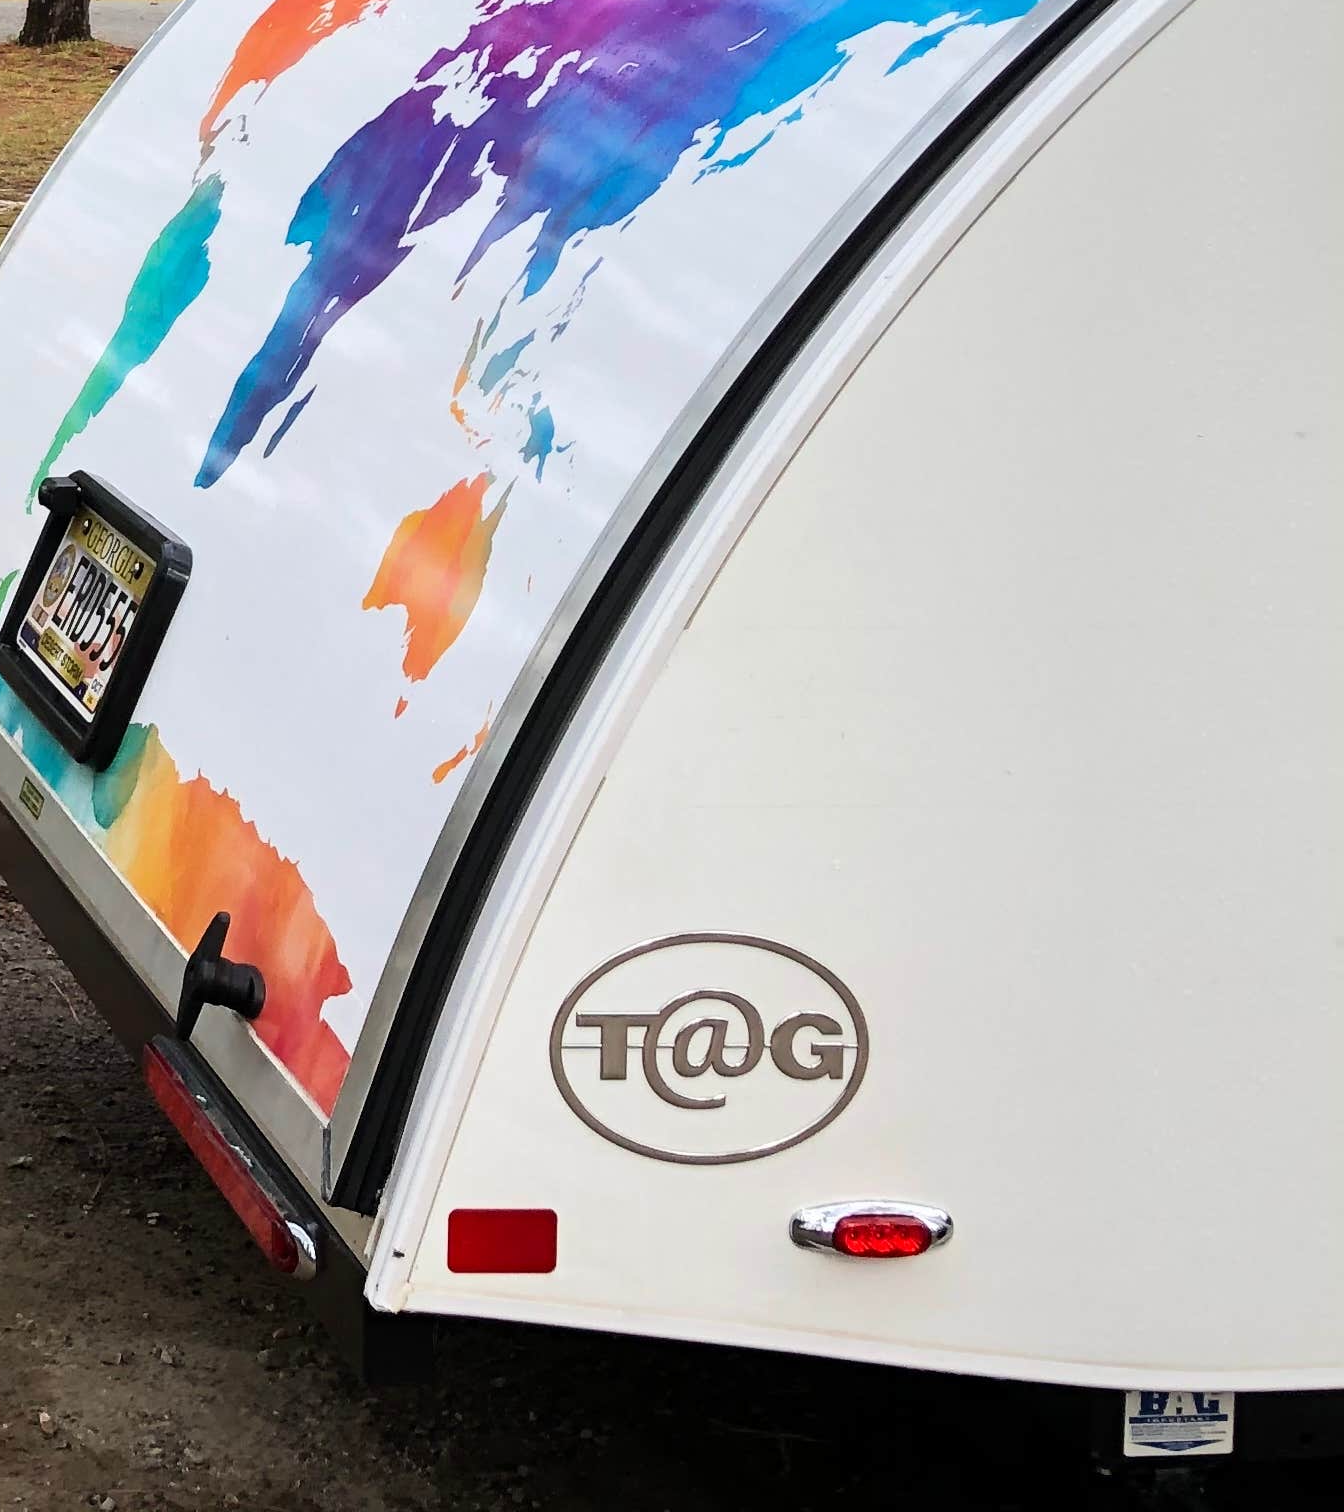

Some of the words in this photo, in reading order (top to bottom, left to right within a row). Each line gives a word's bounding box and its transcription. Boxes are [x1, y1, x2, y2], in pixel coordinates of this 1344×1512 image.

[87, 522, 136, 584] GEORGIA
[40, 632, 64, 662] DESERT
[60, 653, 83, 681] STORM
[52, 555, 138, 671] ERD555
[576, 988, 843, 1110] T@G
